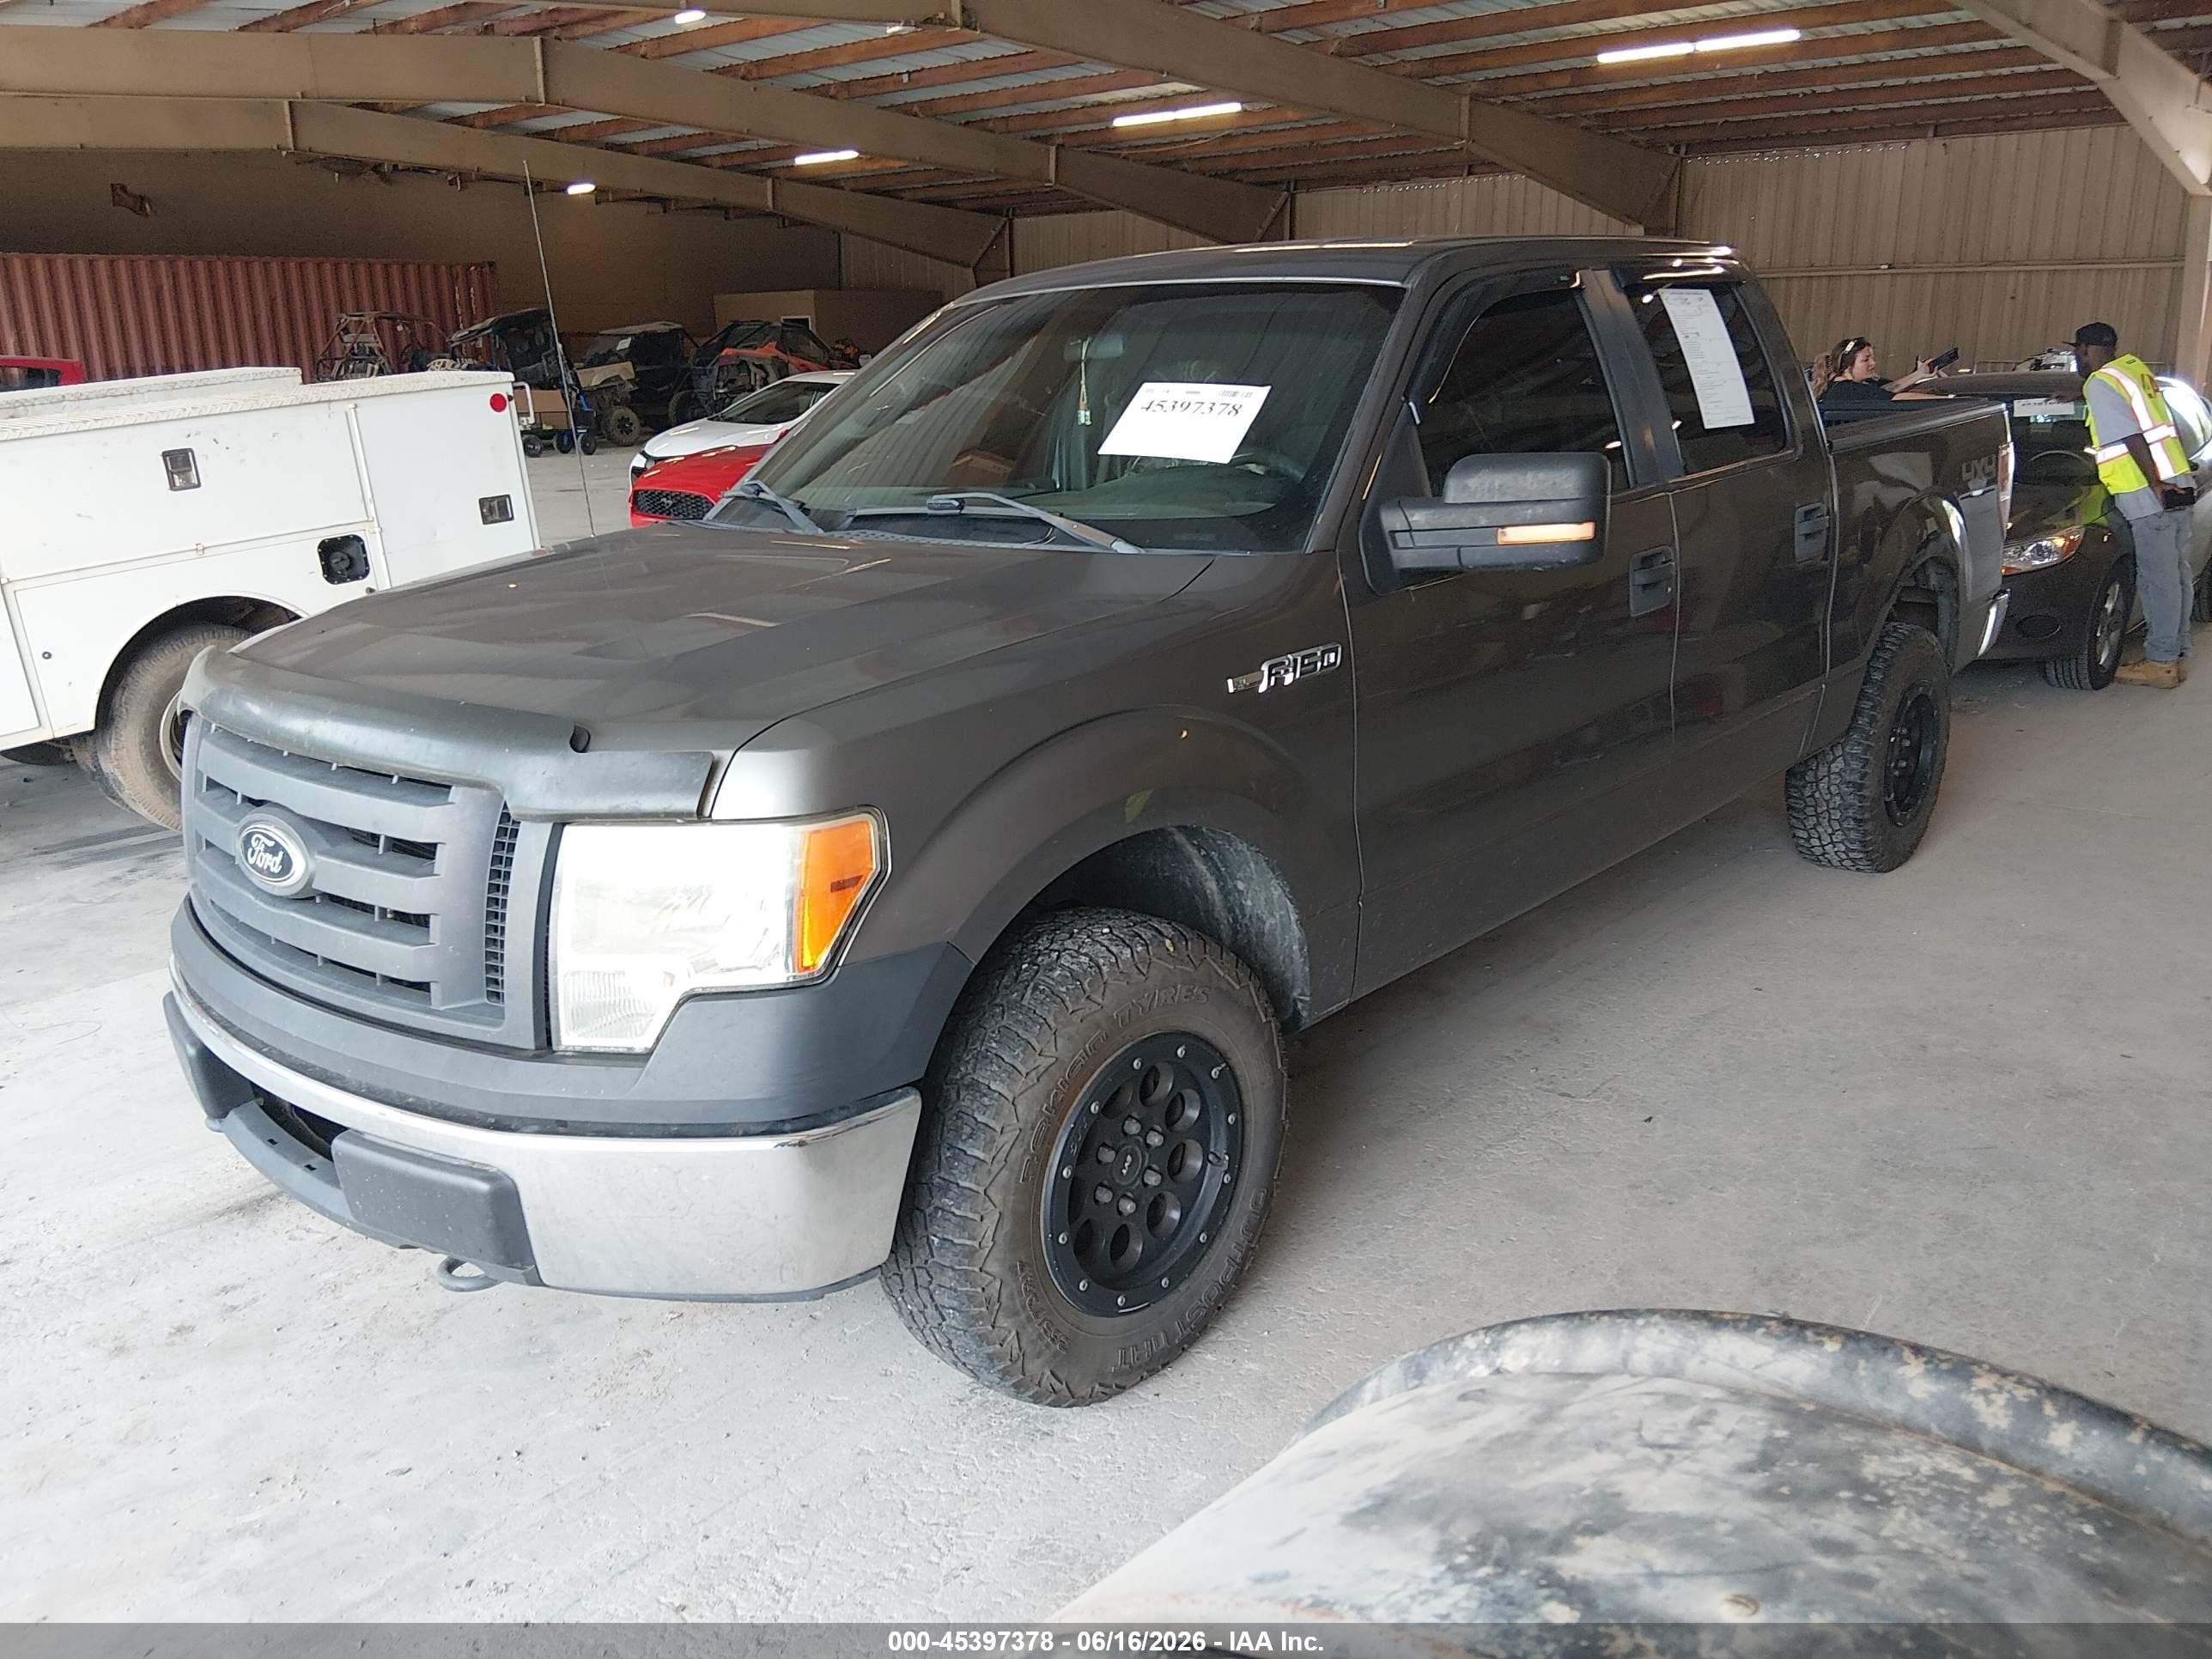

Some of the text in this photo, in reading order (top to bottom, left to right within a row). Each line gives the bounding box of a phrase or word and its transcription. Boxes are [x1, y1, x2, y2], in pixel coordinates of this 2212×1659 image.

[1140, 398, 1243, 418] 45397378
[247, 833, 284, 874] Ford
[1114, 983, 1209, 1028] TYRES
[1175, 1188, 1267, 1344] OUTPOST
